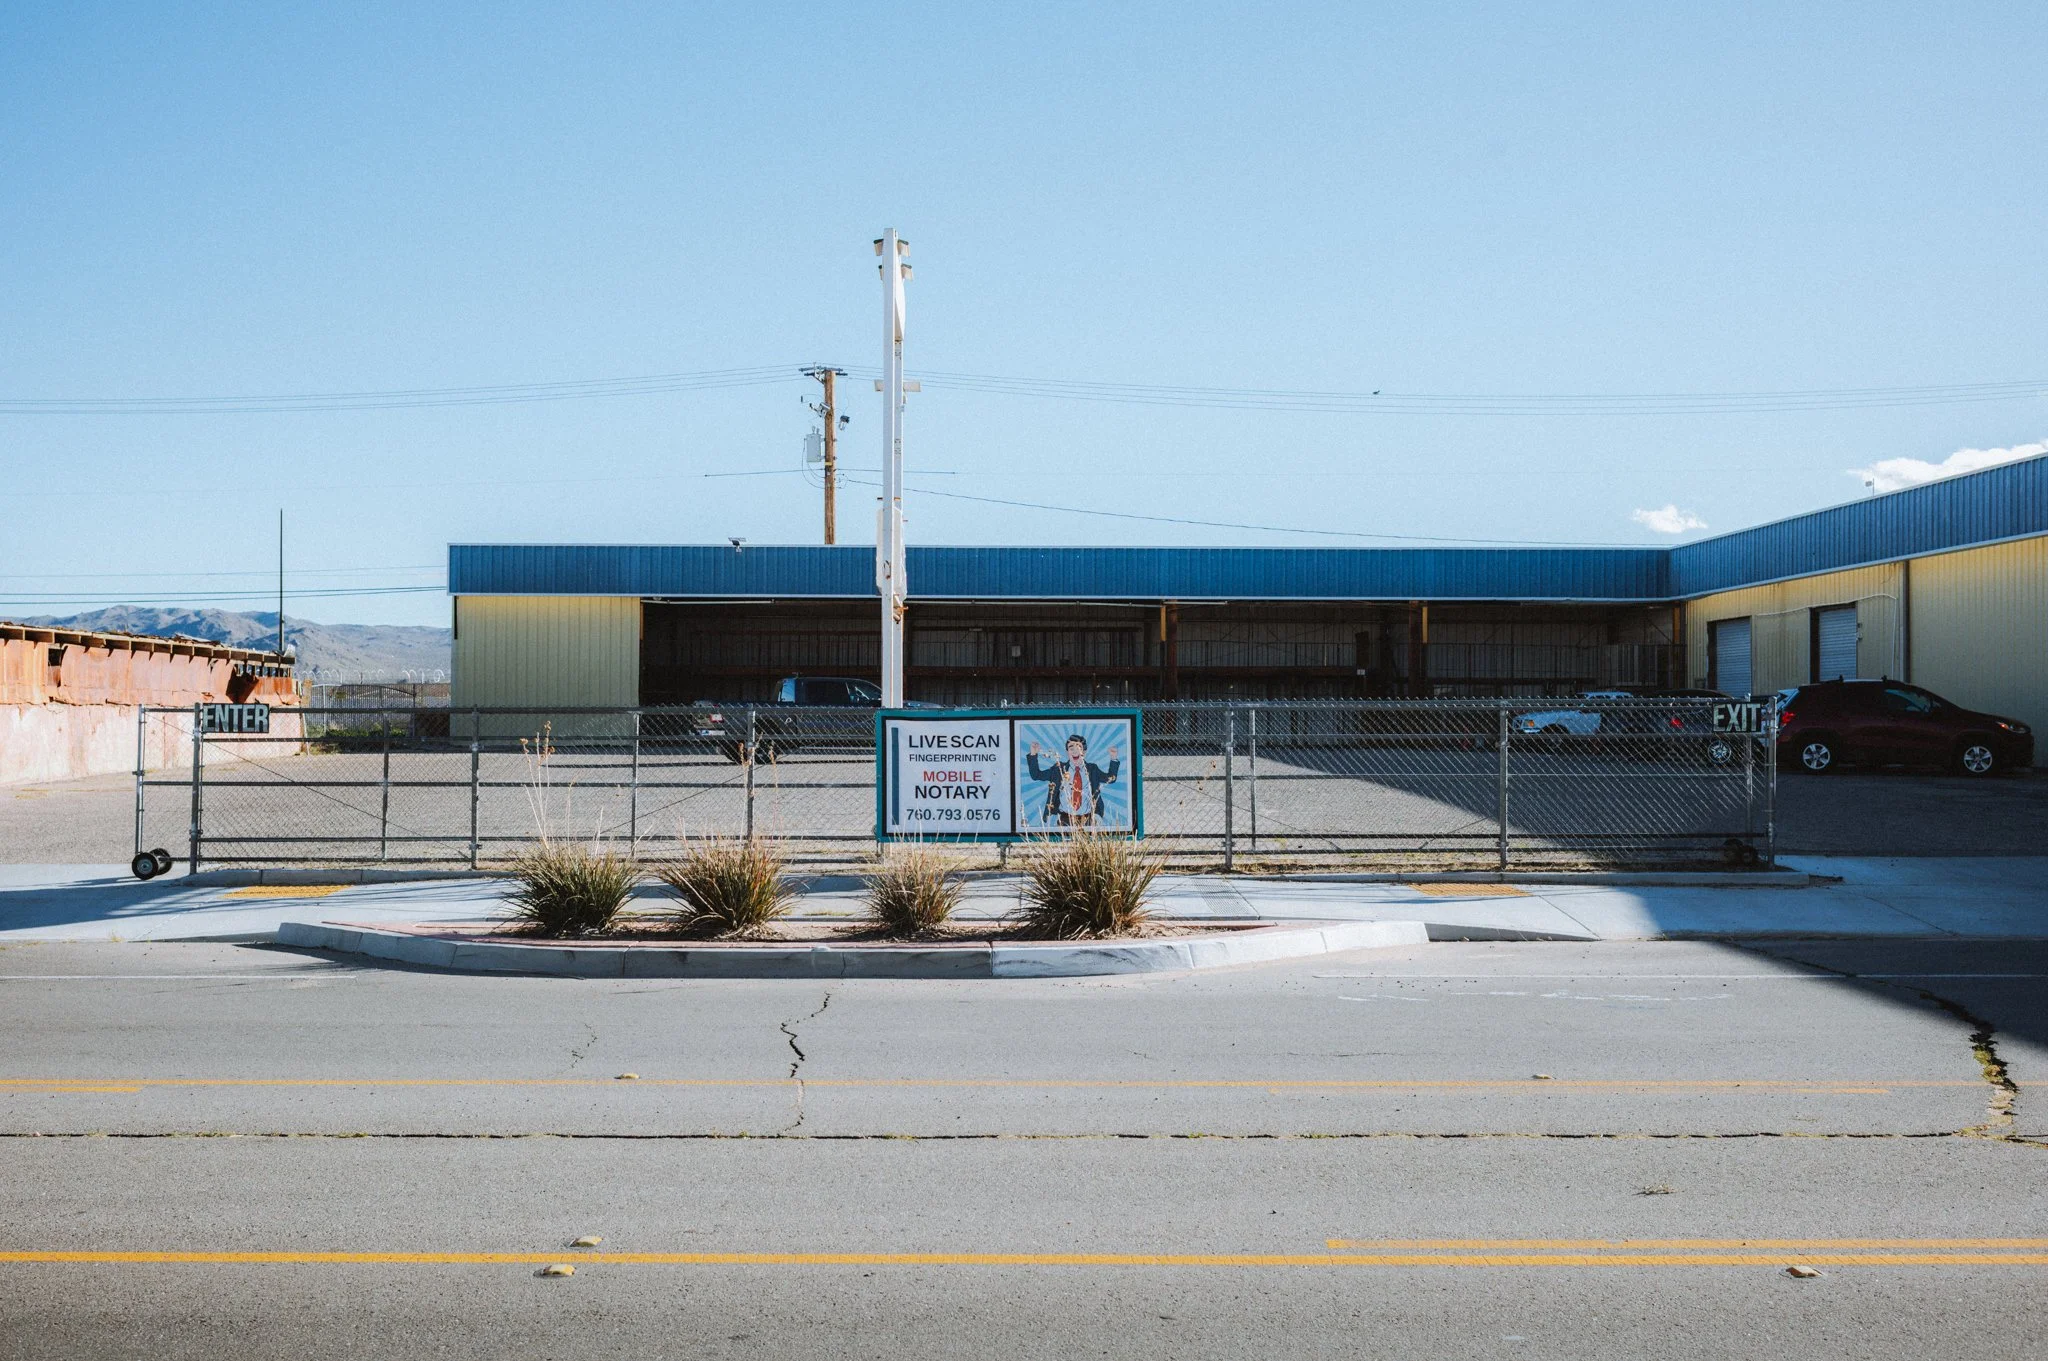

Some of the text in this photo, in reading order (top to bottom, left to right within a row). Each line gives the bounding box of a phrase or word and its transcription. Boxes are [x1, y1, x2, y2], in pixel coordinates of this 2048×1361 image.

[203, 704, 269, 732] ENTER
[1713, 703, 1761, 732] EXIT
[909, 753, 997, 762] FINGERPRINTING
[923, 770, 982, 782] MOBILE
[915, 785, 991, 799] NOTARY
[906, 808, 1001, 821] 760.793.0576
